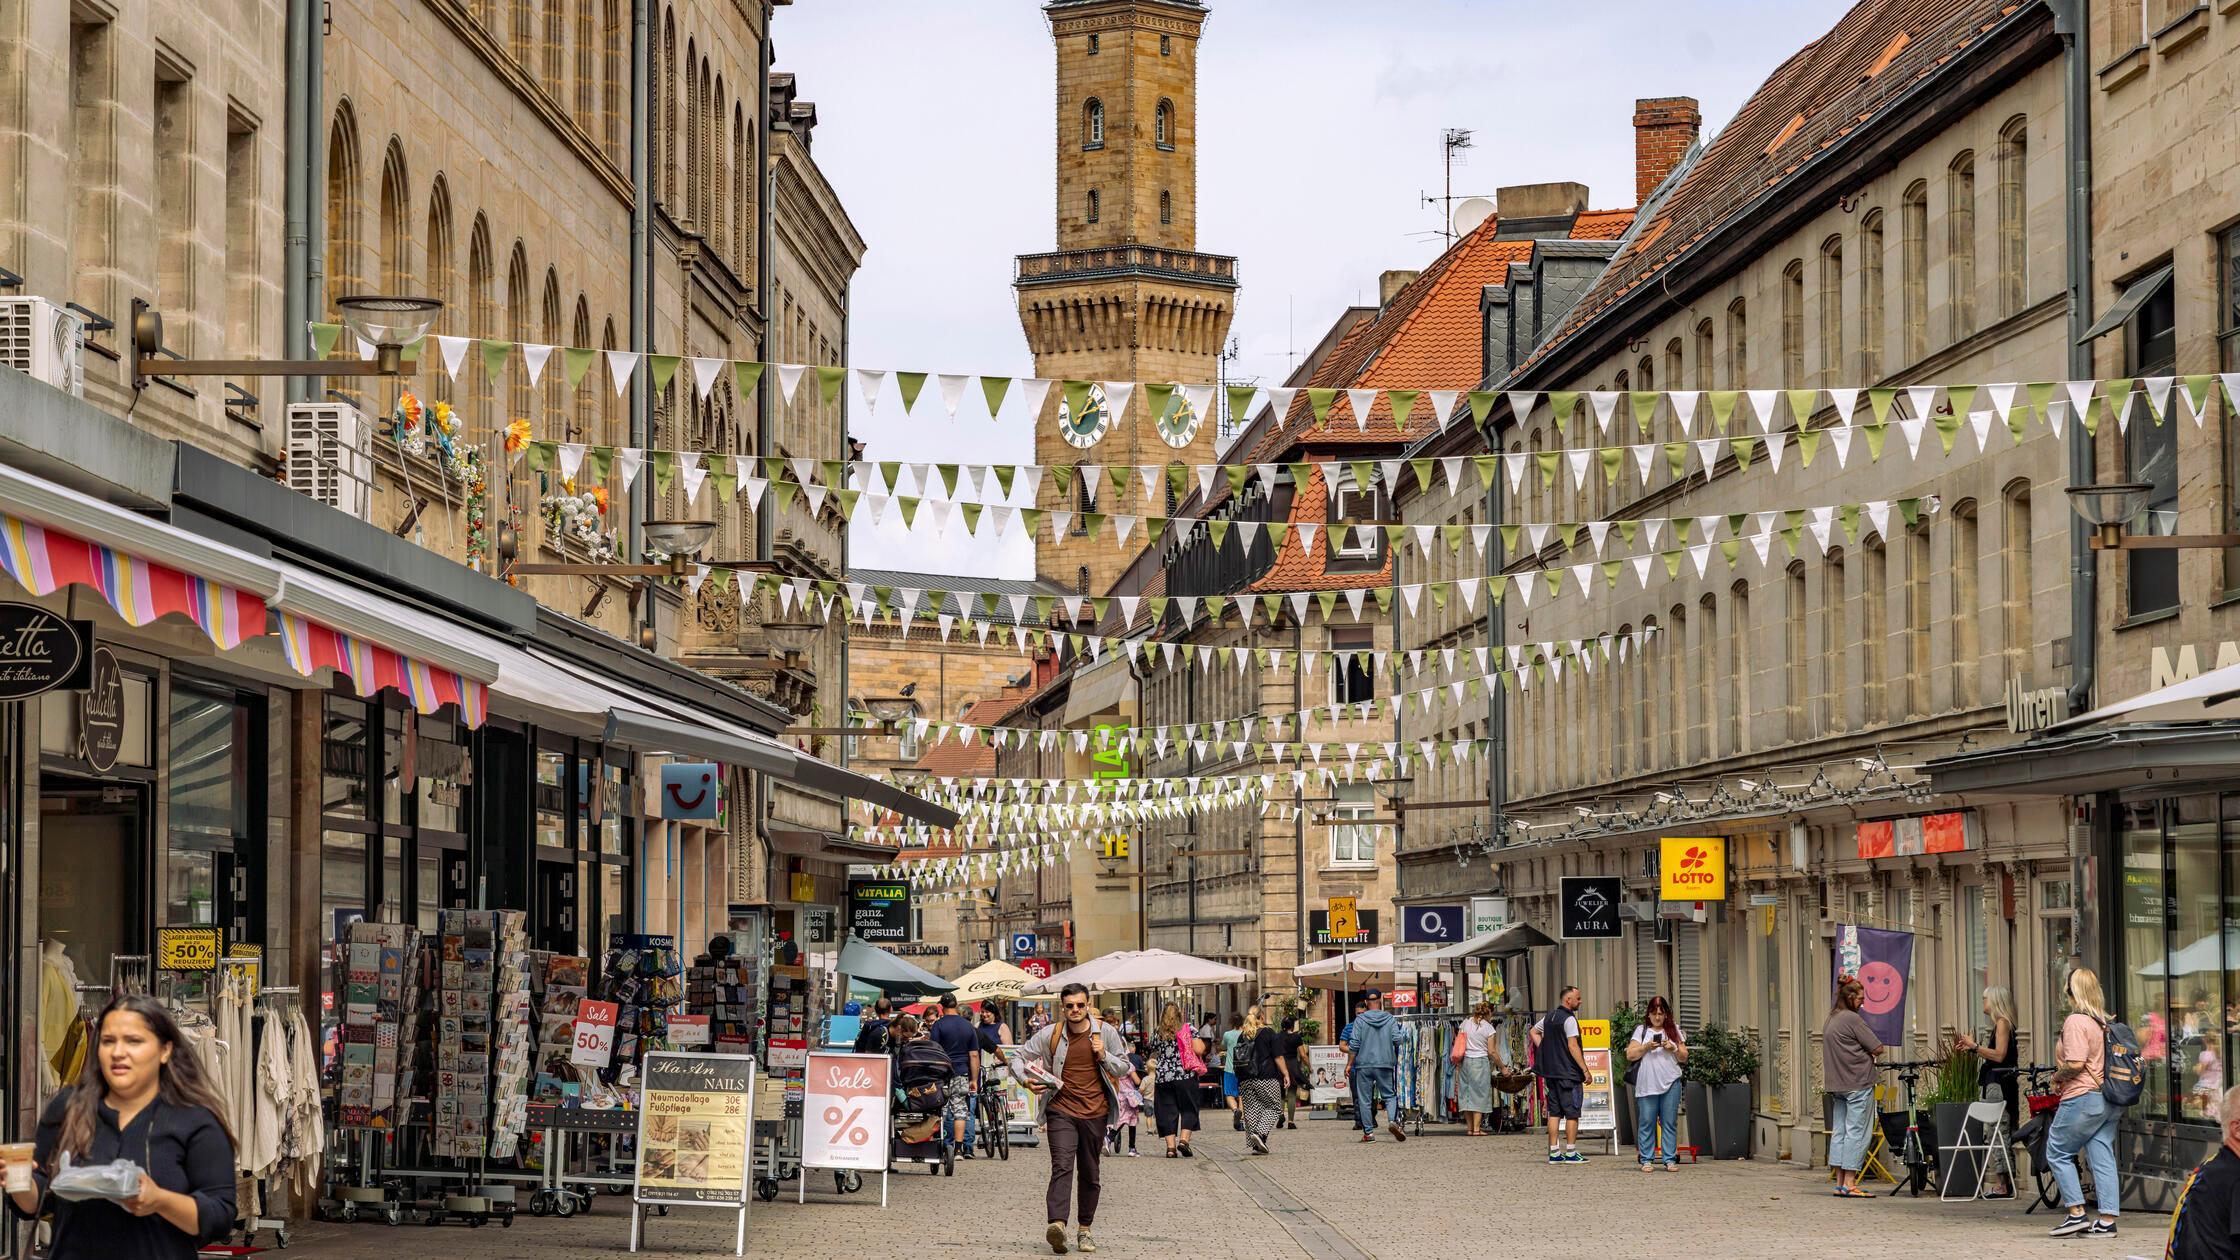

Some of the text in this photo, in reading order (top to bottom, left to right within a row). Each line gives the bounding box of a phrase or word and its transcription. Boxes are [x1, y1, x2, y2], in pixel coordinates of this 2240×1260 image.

[13, 666, 50, 681] italiano
[2006, 672, 2060, 734] Uhren
[1642, 849, 1660, 878] AUR
[1672, 872, 1714, 884] LOTTO
[856, 888, 904, 898] VITALIA
[855, 909, 884, 920] ganz.
[855, 919, 882, 927] schön.
[1574, 921, 1610, 930] AURA
[863, 926, 904, 938] gesund
[169, 944, 214, 958] -50%
[919, 945, 949, 956] DÖNER
[1024, 963, 1046, 977] DER
[1394, 994, 1414, 1003] 20%
[586, 1006, 608, 1022] Sale
[1580, 1026, 1602, 1036] TTO
[576, 1032, 608, 1052] 50%
[683, 1062, 715, 1075] An
[826, 1066, 873, 1089] Sale
[704, 1078, 745, 1091] NAILS
[650, 1092, 741, 1105] Neumodellage 30€
[650, 1102, 740, 1115] Fußpflege 28€
[822, 1106, 870, 1146] %
